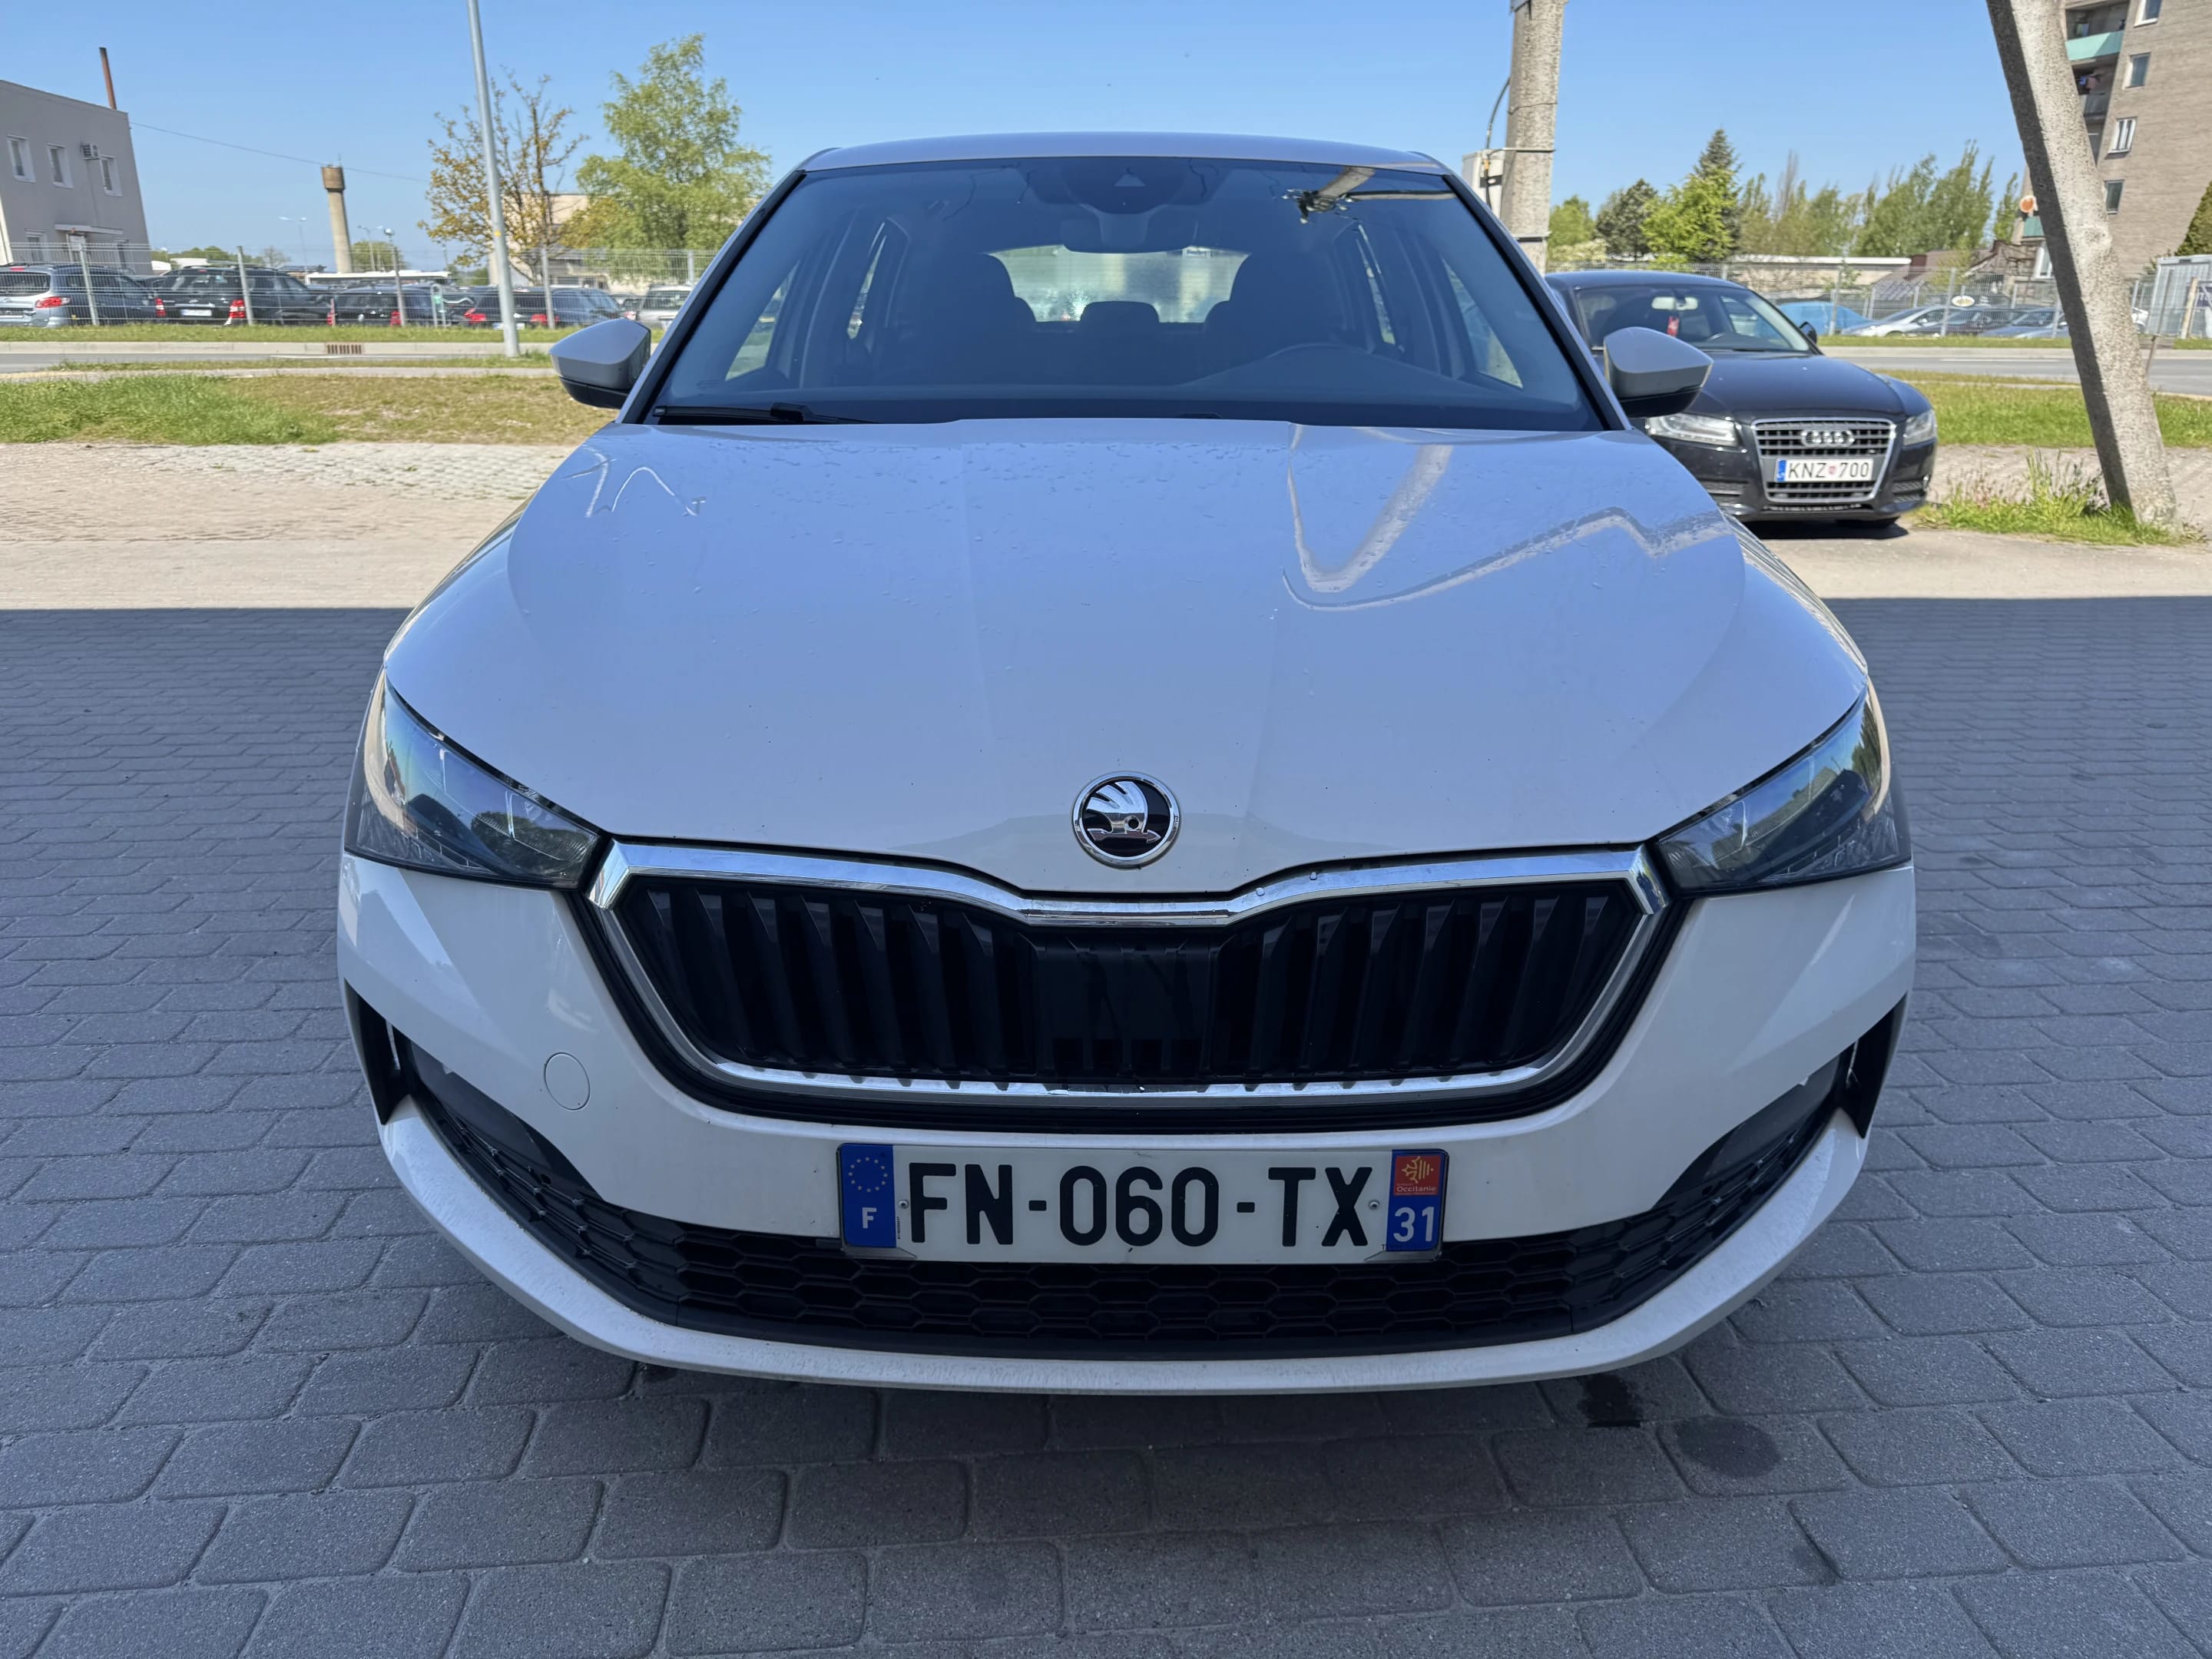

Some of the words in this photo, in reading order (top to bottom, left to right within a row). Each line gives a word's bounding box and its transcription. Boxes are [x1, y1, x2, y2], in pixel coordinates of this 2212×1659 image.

[1788, 462, 1826, 478] KNZ
[1839, 462, 1869, 478] 700
[862, 1207, 877, 1229] F
[909, 1162, 1373, 1247] FN-060-TX
[1393, 1206, 1435, 1243] 31
